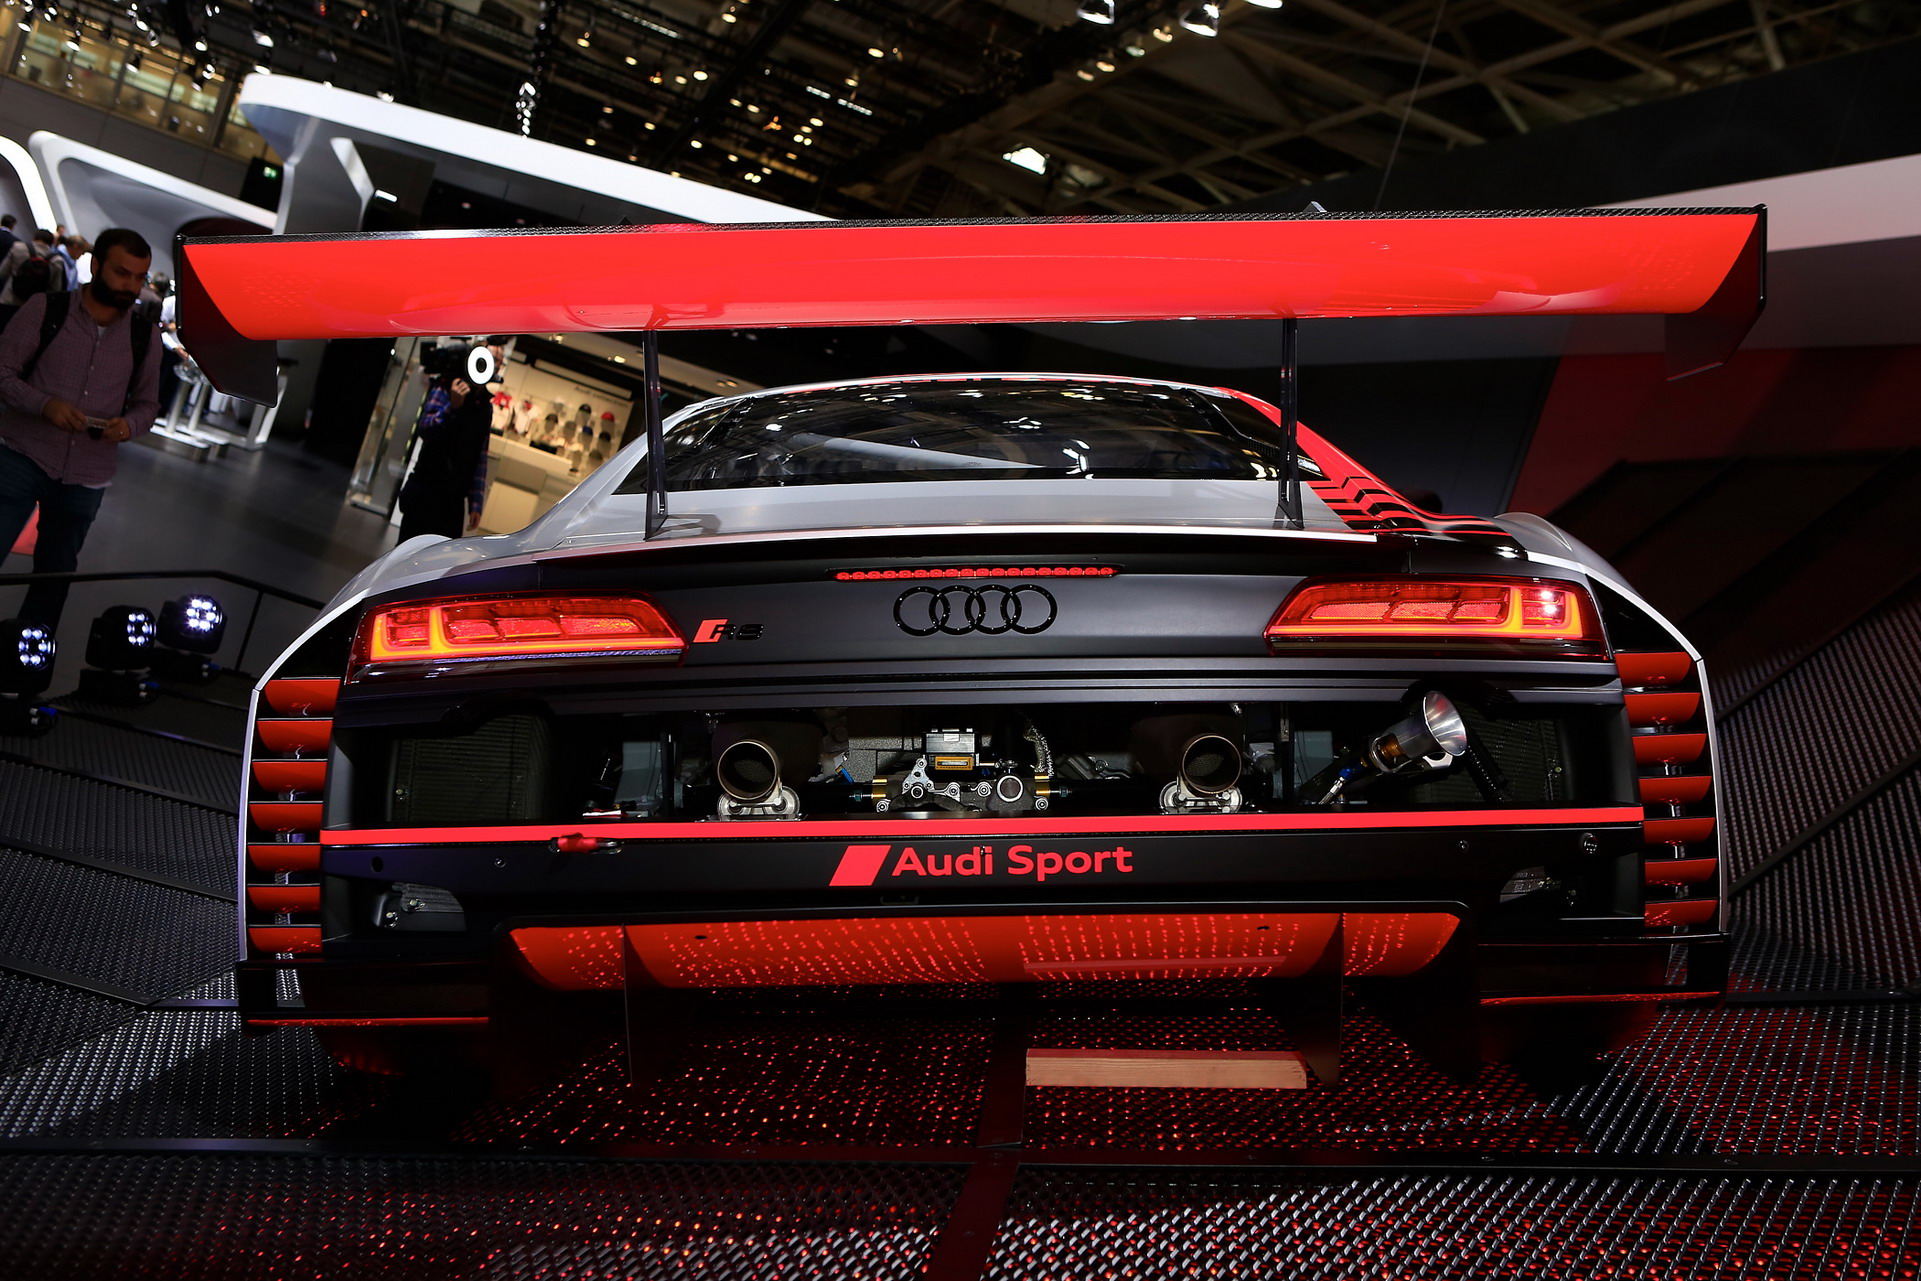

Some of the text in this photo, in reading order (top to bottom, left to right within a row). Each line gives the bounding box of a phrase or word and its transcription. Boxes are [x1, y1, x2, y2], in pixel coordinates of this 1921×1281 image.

[706, 622, 765, 641] R8
[891, 844, 1134, 882] Audi Sport
